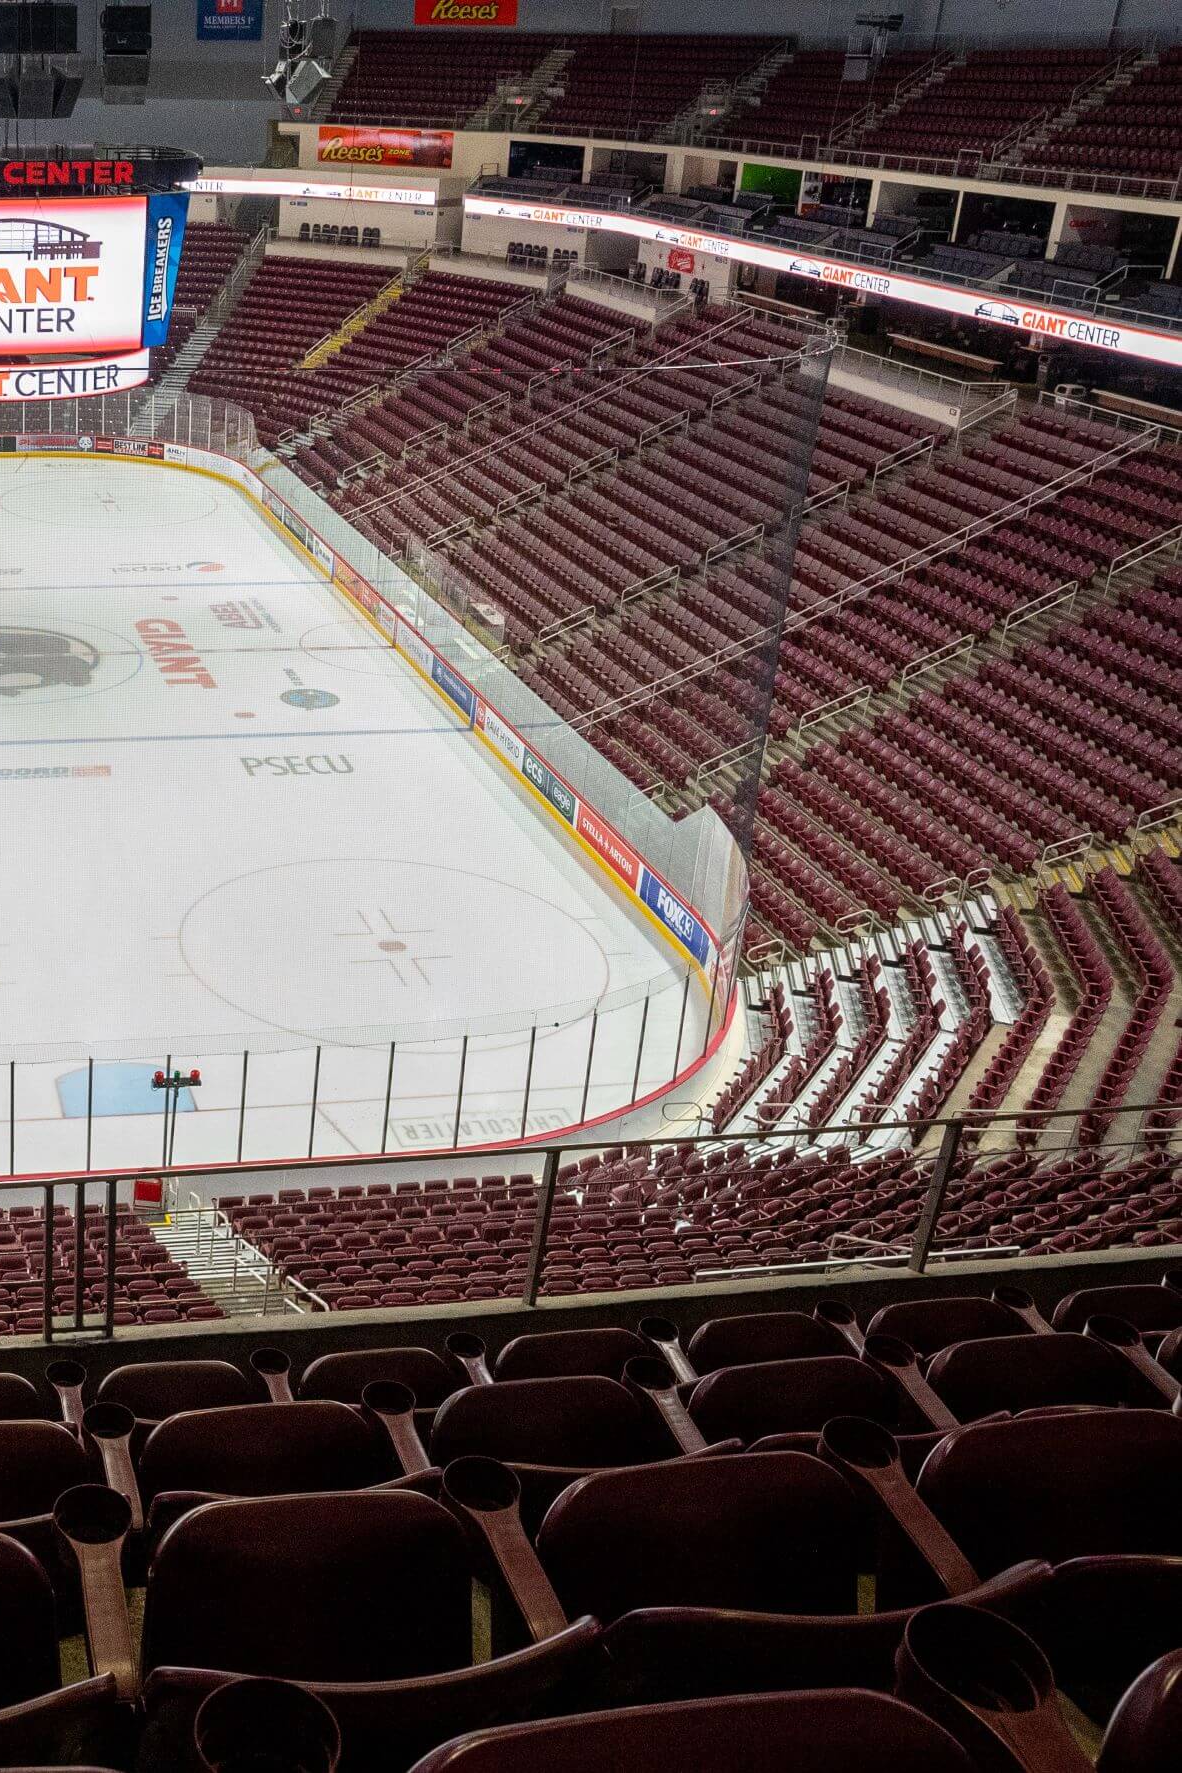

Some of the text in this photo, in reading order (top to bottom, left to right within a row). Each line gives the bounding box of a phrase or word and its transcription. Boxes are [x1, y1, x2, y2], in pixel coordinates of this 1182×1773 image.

[204, 16, 246, 25] MEMBERS
[431, 0, 500, 20] Reese's
[322, 137, 385, 162] Reese's
[3, 161, 134, 186] CENTER
[188, 180, 224, 192] ENTER
[344, 188, 378, 199] GIANT
[533, 209, 603, 227] GIANT CENTER
[680, 233, 730, 256] GIANT CENTER
[147, 217, 173, 321] ICE BREAKERS
[822, 266, 890, 294] GIANT CENTER
[1022, 311, 1120, 348] GIANT CENTER
[14, 364, 120, 396] CENTER
[114, 440, 132, 450] BEST
[133, 442, 147, 451] LINE
[135, 617, 217, 689] GIANT
[240, 754, 355, 777] PSECU
[526, 756, 543, 784] ecs
[553, 786, 571, 810] eagle
[582, 817, 633, 875] STELLA ARTOIS
